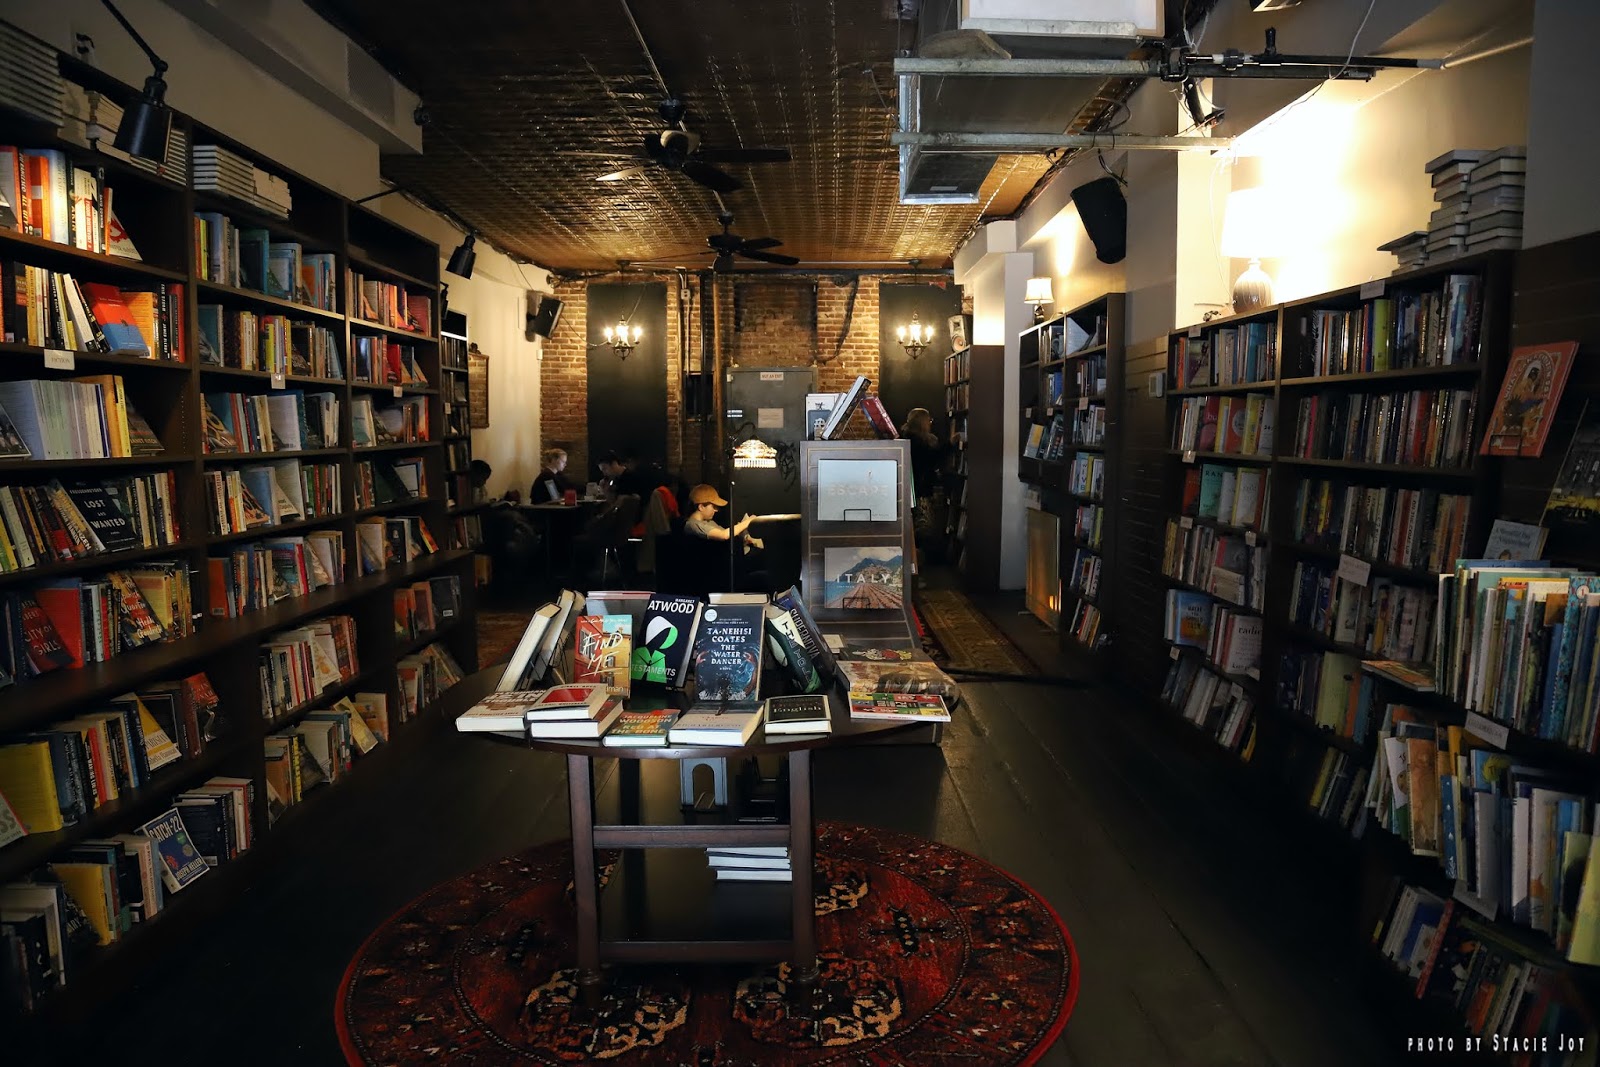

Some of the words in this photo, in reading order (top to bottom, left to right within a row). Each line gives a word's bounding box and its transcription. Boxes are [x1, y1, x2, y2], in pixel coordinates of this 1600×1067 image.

[828, 485, 889, 496] ESCAPE
[83, 499, 106, 508] LOST
[89, 518, 126, 529] WANTED
[836, 573, 891, 583] ITALY
[648, 600, 694, 614] ATWOOD
[24, 628, 44, 643] CITY
[790, 608, 820, 659] SUPERNOVA
[33, 639, 62, 656] GIRLS
[587, 650, 620, 677] ME
[631, 664, 676, 677] TESTAMENTS
[149, 815, 182, 842] CATCH-22
[175, 865, 191, 880] JOSEPH
[189, 857, 203, 872] HELLER
